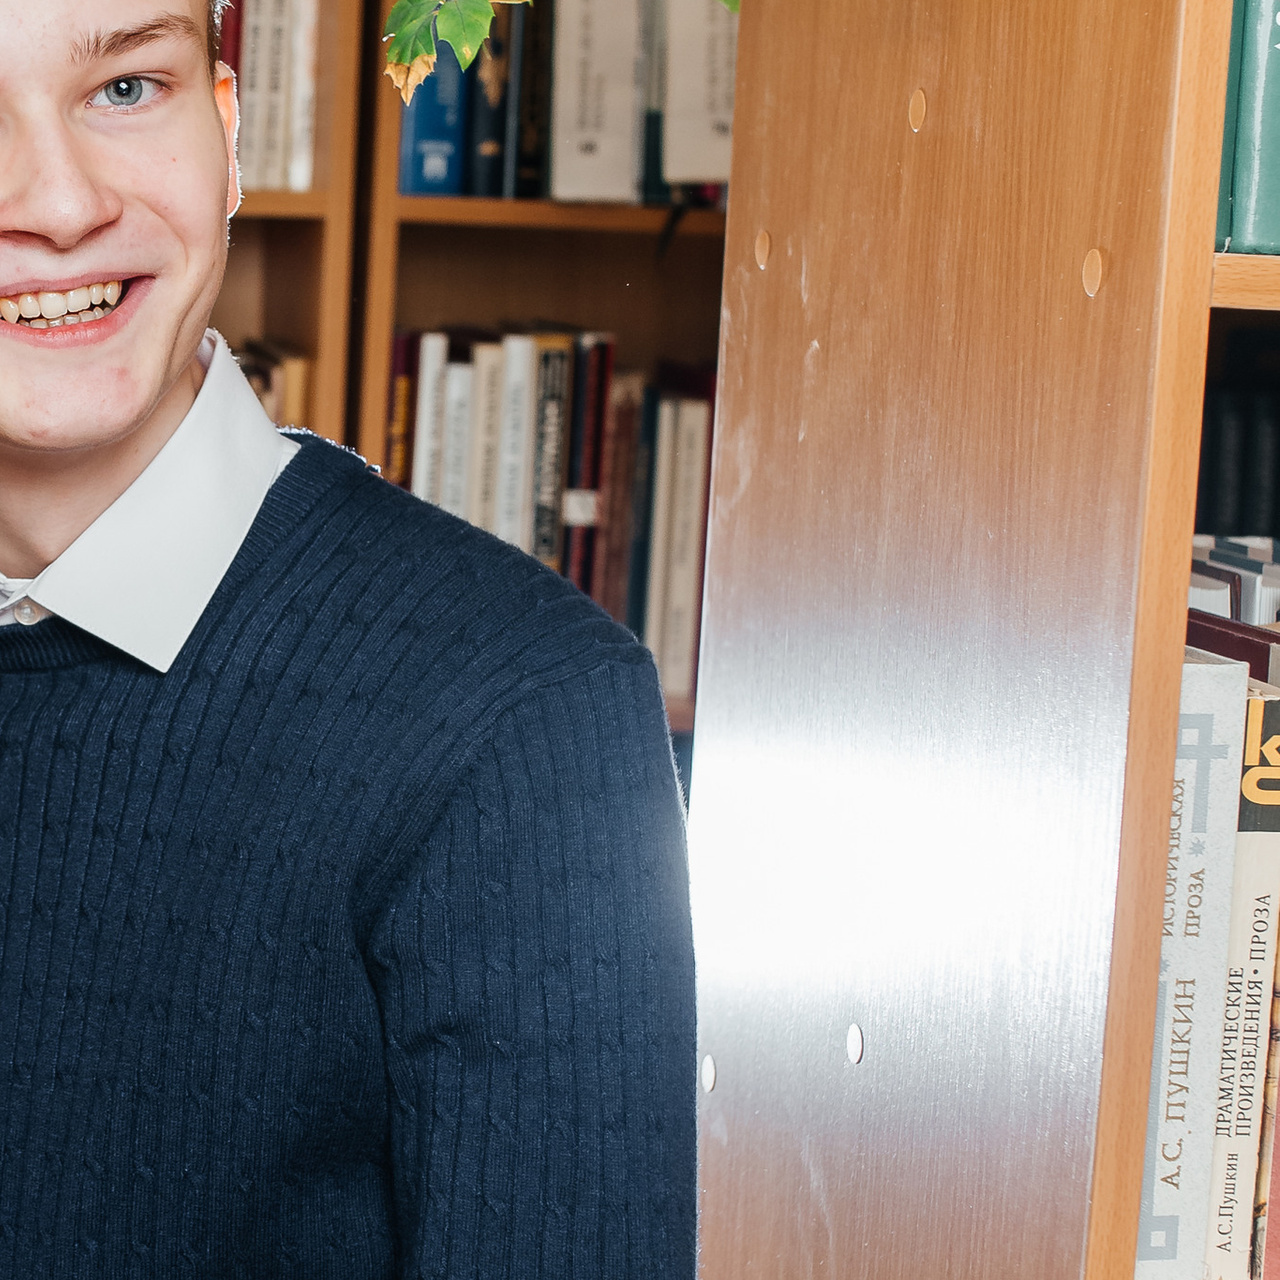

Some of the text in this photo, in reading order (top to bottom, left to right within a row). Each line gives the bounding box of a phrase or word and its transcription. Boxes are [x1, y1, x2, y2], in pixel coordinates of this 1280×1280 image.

[1184, 868, 1205, 938] ПРОЗА
[1160, 978, 1196, 1190] А.С. ПУШКИН
[1215, 967, 1244, 1138] ДРАМАТИЧЕСКИЕ
[1235, 894, 1271, 1137] ПРОИЗВЕДЕНИЯ ПРОЗА
[1216, 1152, 1239, 1252] А.С.Пушкин
